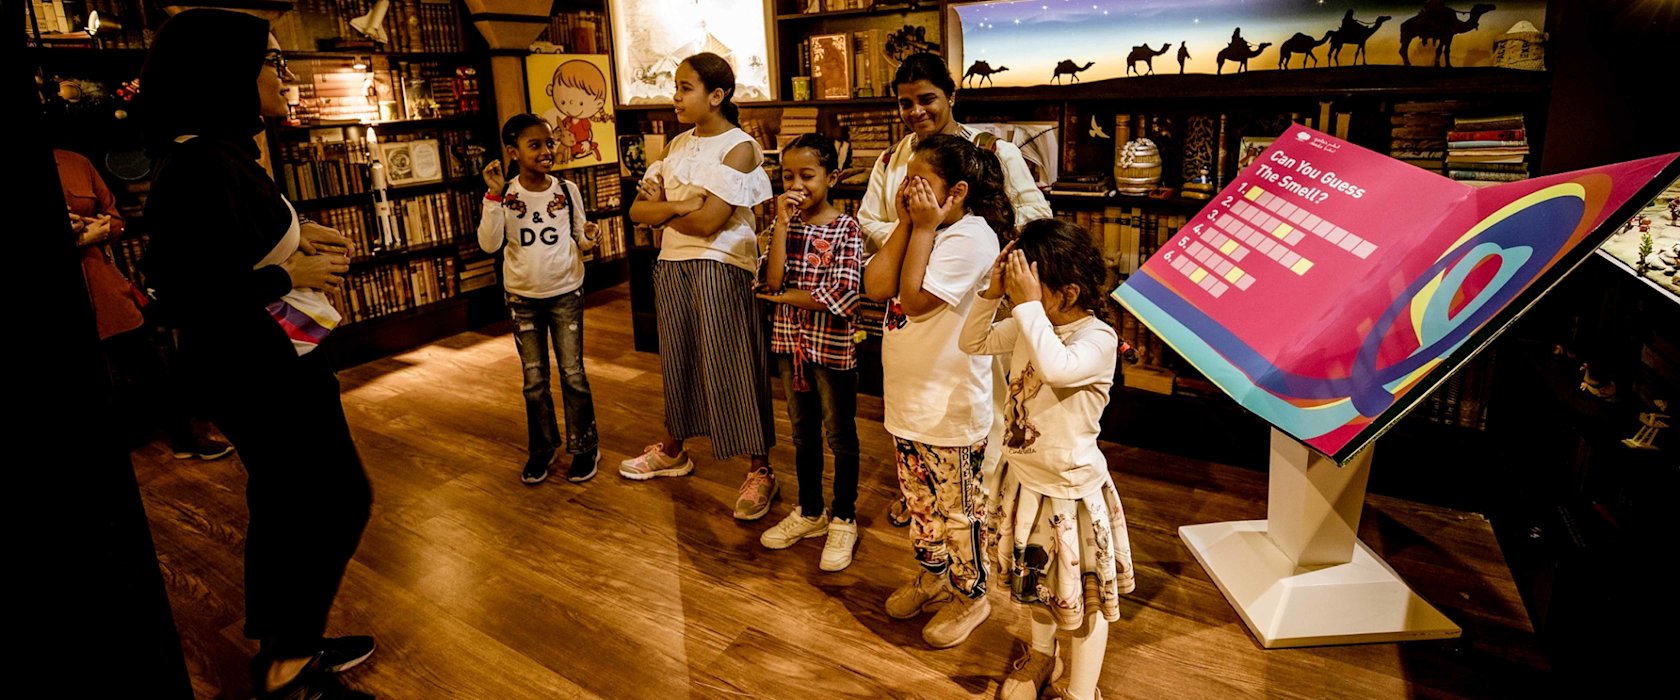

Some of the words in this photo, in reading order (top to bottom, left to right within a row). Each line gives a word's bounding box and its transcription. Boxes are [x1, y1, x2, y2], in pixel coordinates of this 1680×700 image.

[1270, 150, 1296, 169] Can
[1296, 160, 1322, 180] You
[1320, 171, 1367, 199] Guess
[1237, 182, 1248, 194] 1.
[1255, 163, 1280, 183] The
[1277, 175, 1329, 205] Smell?
[1221, 195, 1234, 208] 2.
[532, 211, 544, 224] &
[1207, 209, 1219, 222] 3.
[1192, 223, 1204, 236] 4.
[520, 226, 559, 247] DG
[1177, 235, 1190, 249] 5.
[1163, 250, 1175, 263] 6.
